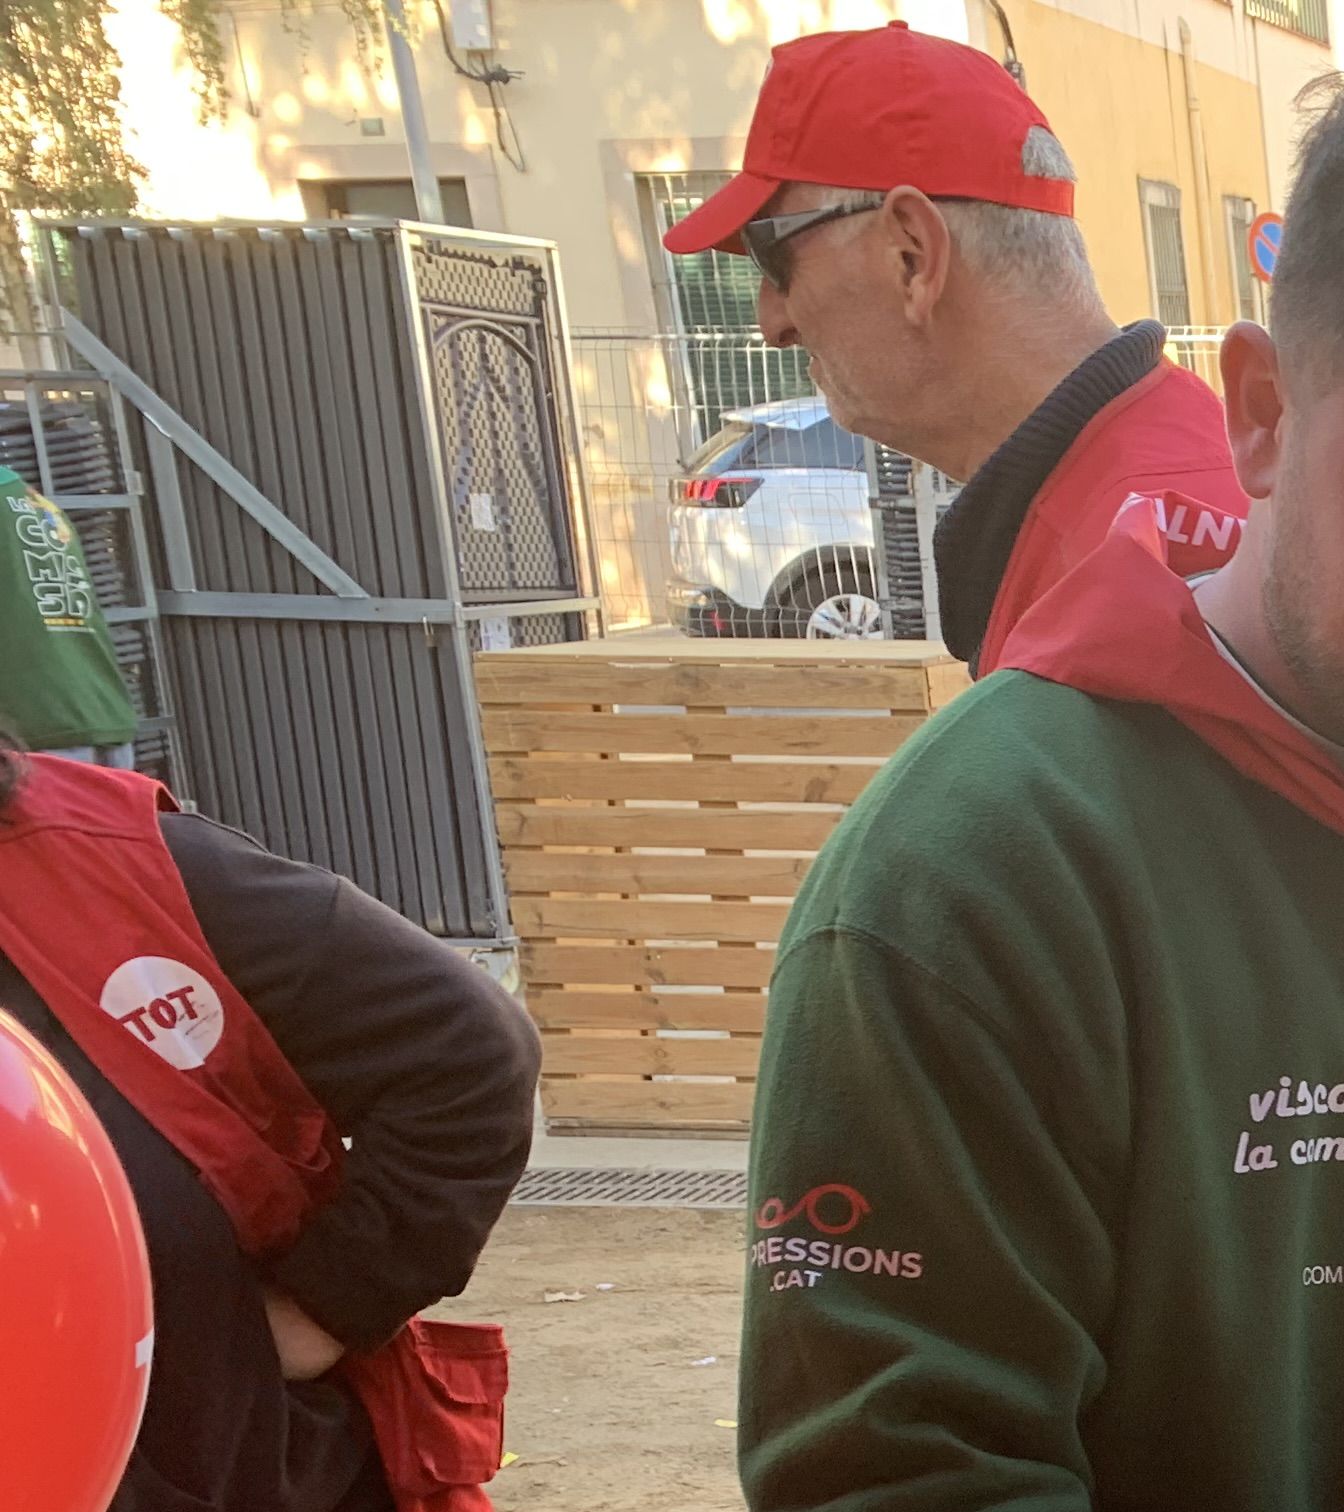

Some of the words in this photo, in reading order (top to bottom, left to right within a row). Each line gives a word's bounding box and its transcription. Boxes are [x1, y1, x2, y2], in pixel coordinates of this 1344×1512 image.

[118, 986, 198, 1042] TOT
[1234, 1132, 1278, 1174] la
[770, 1269, 823, 1292] .CAT
